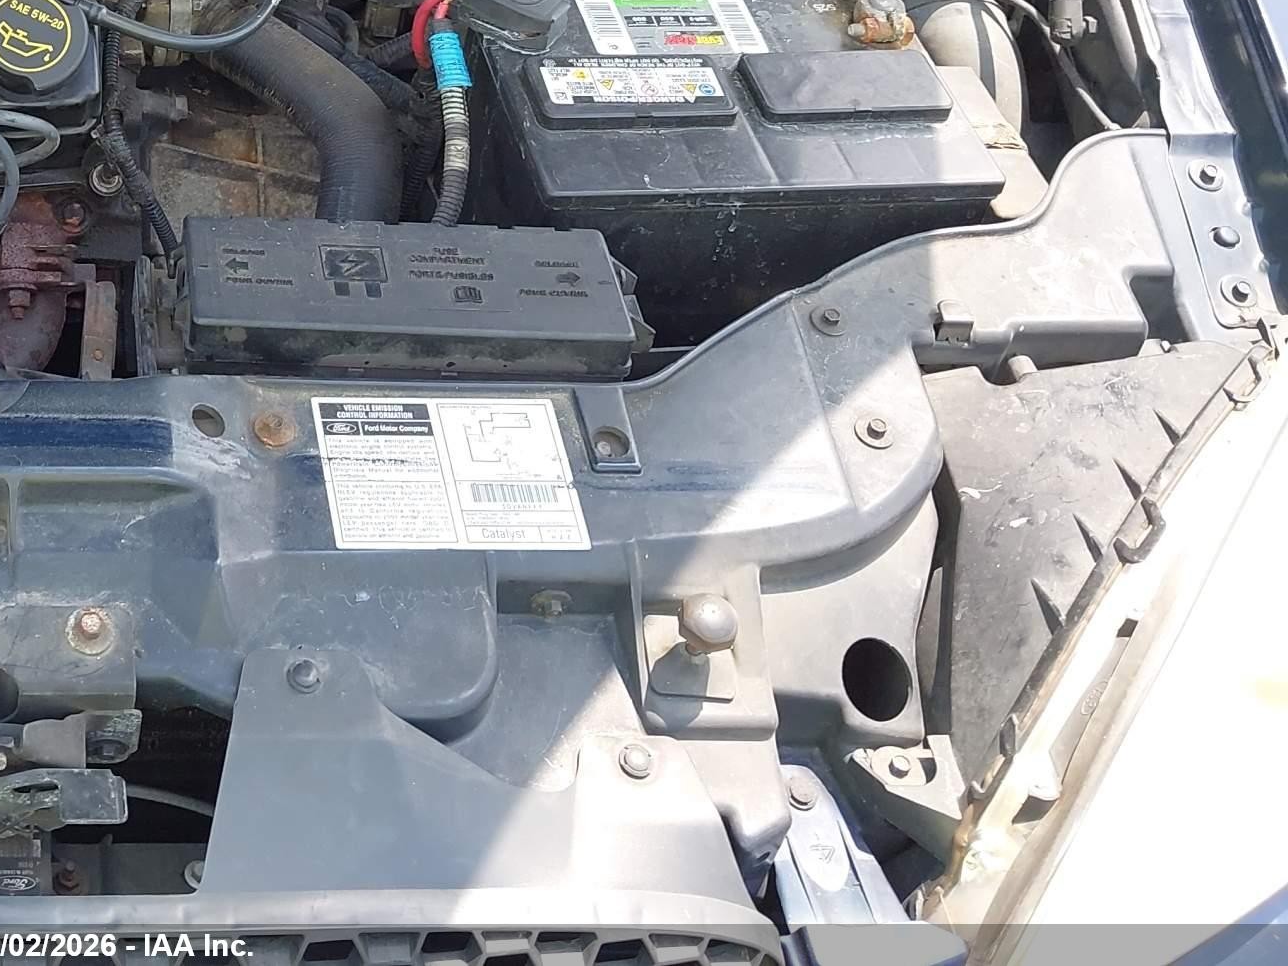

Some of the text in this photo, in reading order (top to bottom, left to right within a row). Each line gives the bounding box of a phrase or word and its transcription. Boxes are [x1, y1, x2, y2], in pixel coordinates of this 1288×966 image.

[10, 0, 64, 30] SAE 5W-20
[343, 404, 371, 412] VEHICLE
[336, 411, 368, 419] CONTROL
[398, 425, 429, 433] Company
[481, 527, 528, 540] Catalyst
